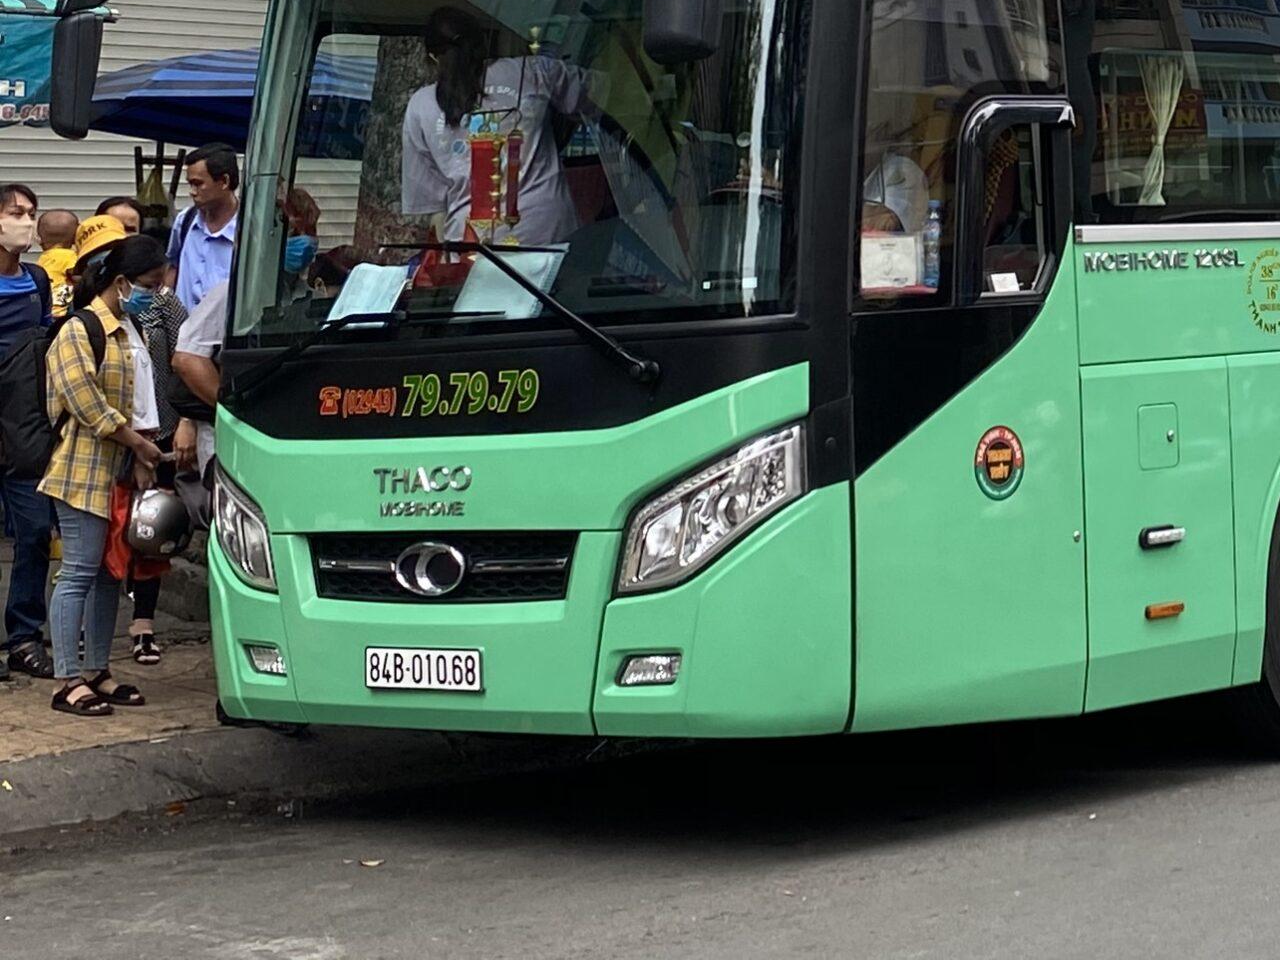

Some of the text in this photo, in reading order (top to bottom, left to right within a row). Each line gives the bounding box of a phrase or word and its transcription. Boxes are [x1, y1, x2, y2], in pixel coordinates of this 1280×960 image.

[1084, 249, 1189, 272] MOBIHOME
[402, 369, 540, 416] 79.79.79
[373, 465, 472, 494] THACO
[380, 501, 465, 517] MOBIHOME
[370, 652, 475, 685] 84B-010.68
